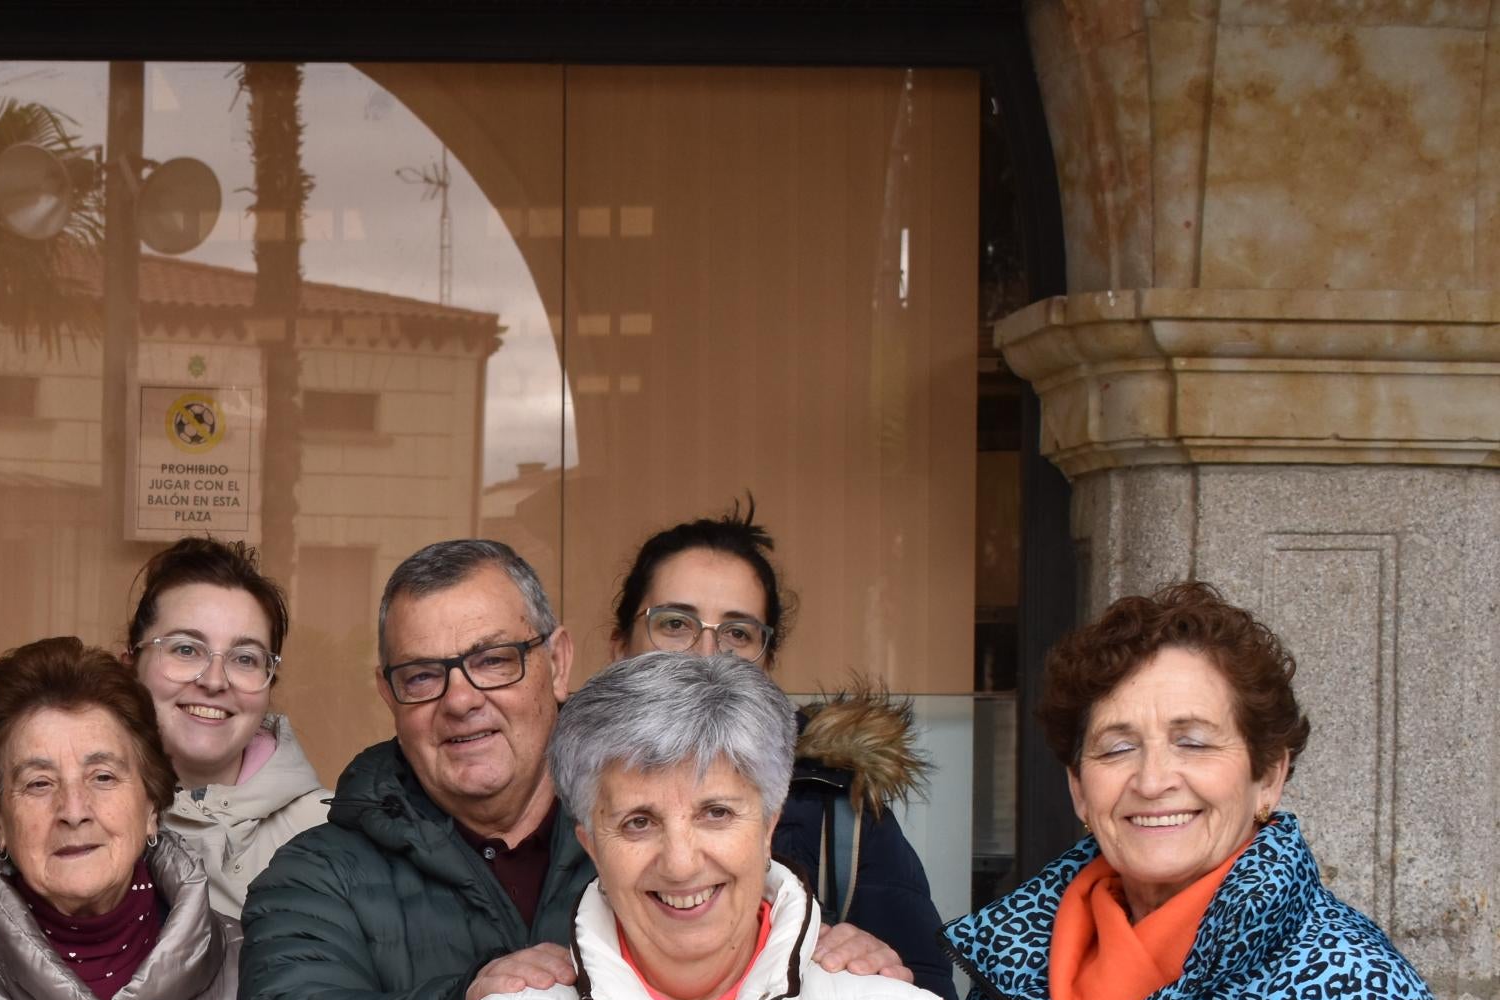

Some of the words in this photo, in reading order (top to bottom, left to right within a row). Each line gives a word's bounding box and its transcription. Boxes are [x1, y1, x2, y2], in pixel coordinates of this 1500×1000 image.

[161, 463, 229, 476] PROHIBIDO
[148, 479, 190, 491] JUGAR
[194, 480, 224, 491] CON
[227, 481, 240, 492] EL
[147, 492, 189, 506] BALÓN
[193, 496, 209, 506] EN
[213, 496, 241, 507] ESTA
[174, 511, 212, 522] PLAZA
